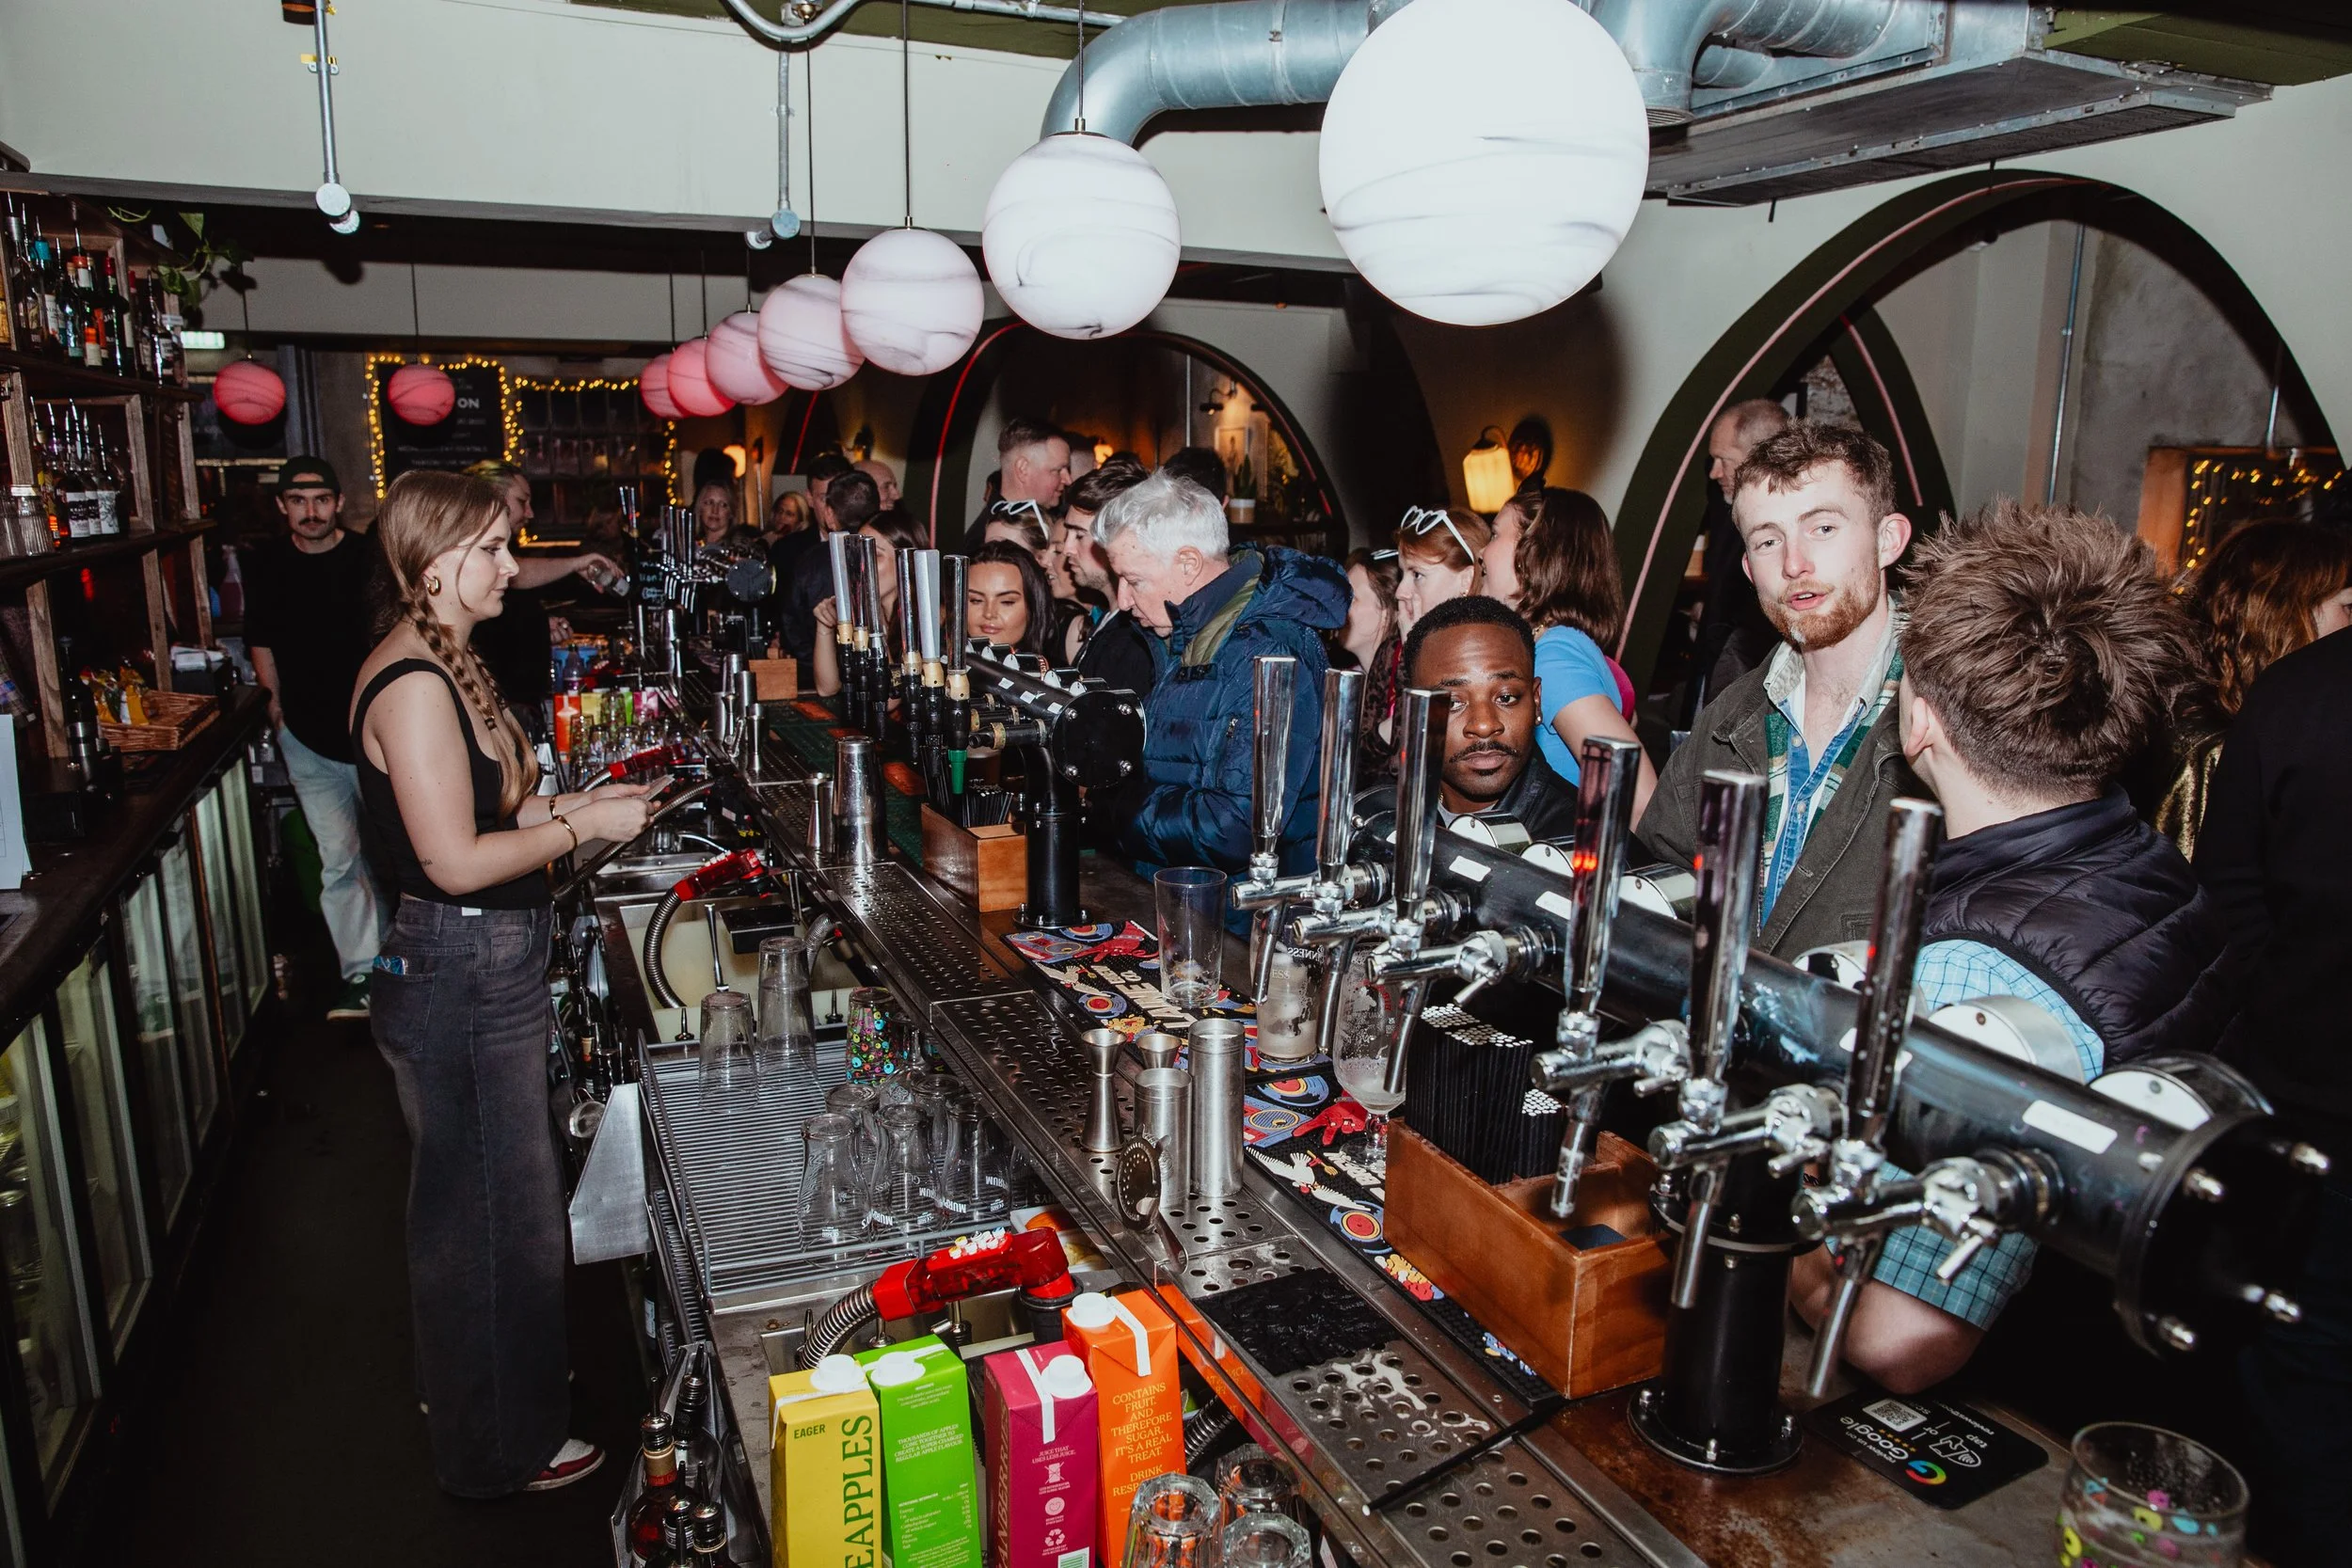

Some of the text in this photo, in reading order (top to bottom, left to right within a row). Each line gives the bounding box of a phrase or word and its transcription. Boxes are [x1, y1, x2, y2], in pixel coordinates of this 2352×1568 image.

[457, 398, 480, 408] ON
[1115, 983, 1198, 1029] LAINE
[1113, 1382, 1167, 1405] CONTAINS
[1125, 1397, 1157, 1412] FRUIT.
[1130, 1408, 1153, 1422] AND
[794, 1424, 826, 1439] EAGER
[1111, 1412, 1173, 1437] THEREFORE
[1125, 1428, 1164, 1444] SUGAR.
[1840, 1417, 1909, 1460] Google
[1965, 1433, 1988, 1449] tap
[1115, 1433, 1172, 1457] IT'S A REAL
[1128, 1448, 1162, 1465] TREAT.
[1130, 1465, 1164, 1482] DRINK
[997, 1397, 1009, 1568] ANBERRIES
[841, 1415, 874, 1568] EAPPLES
